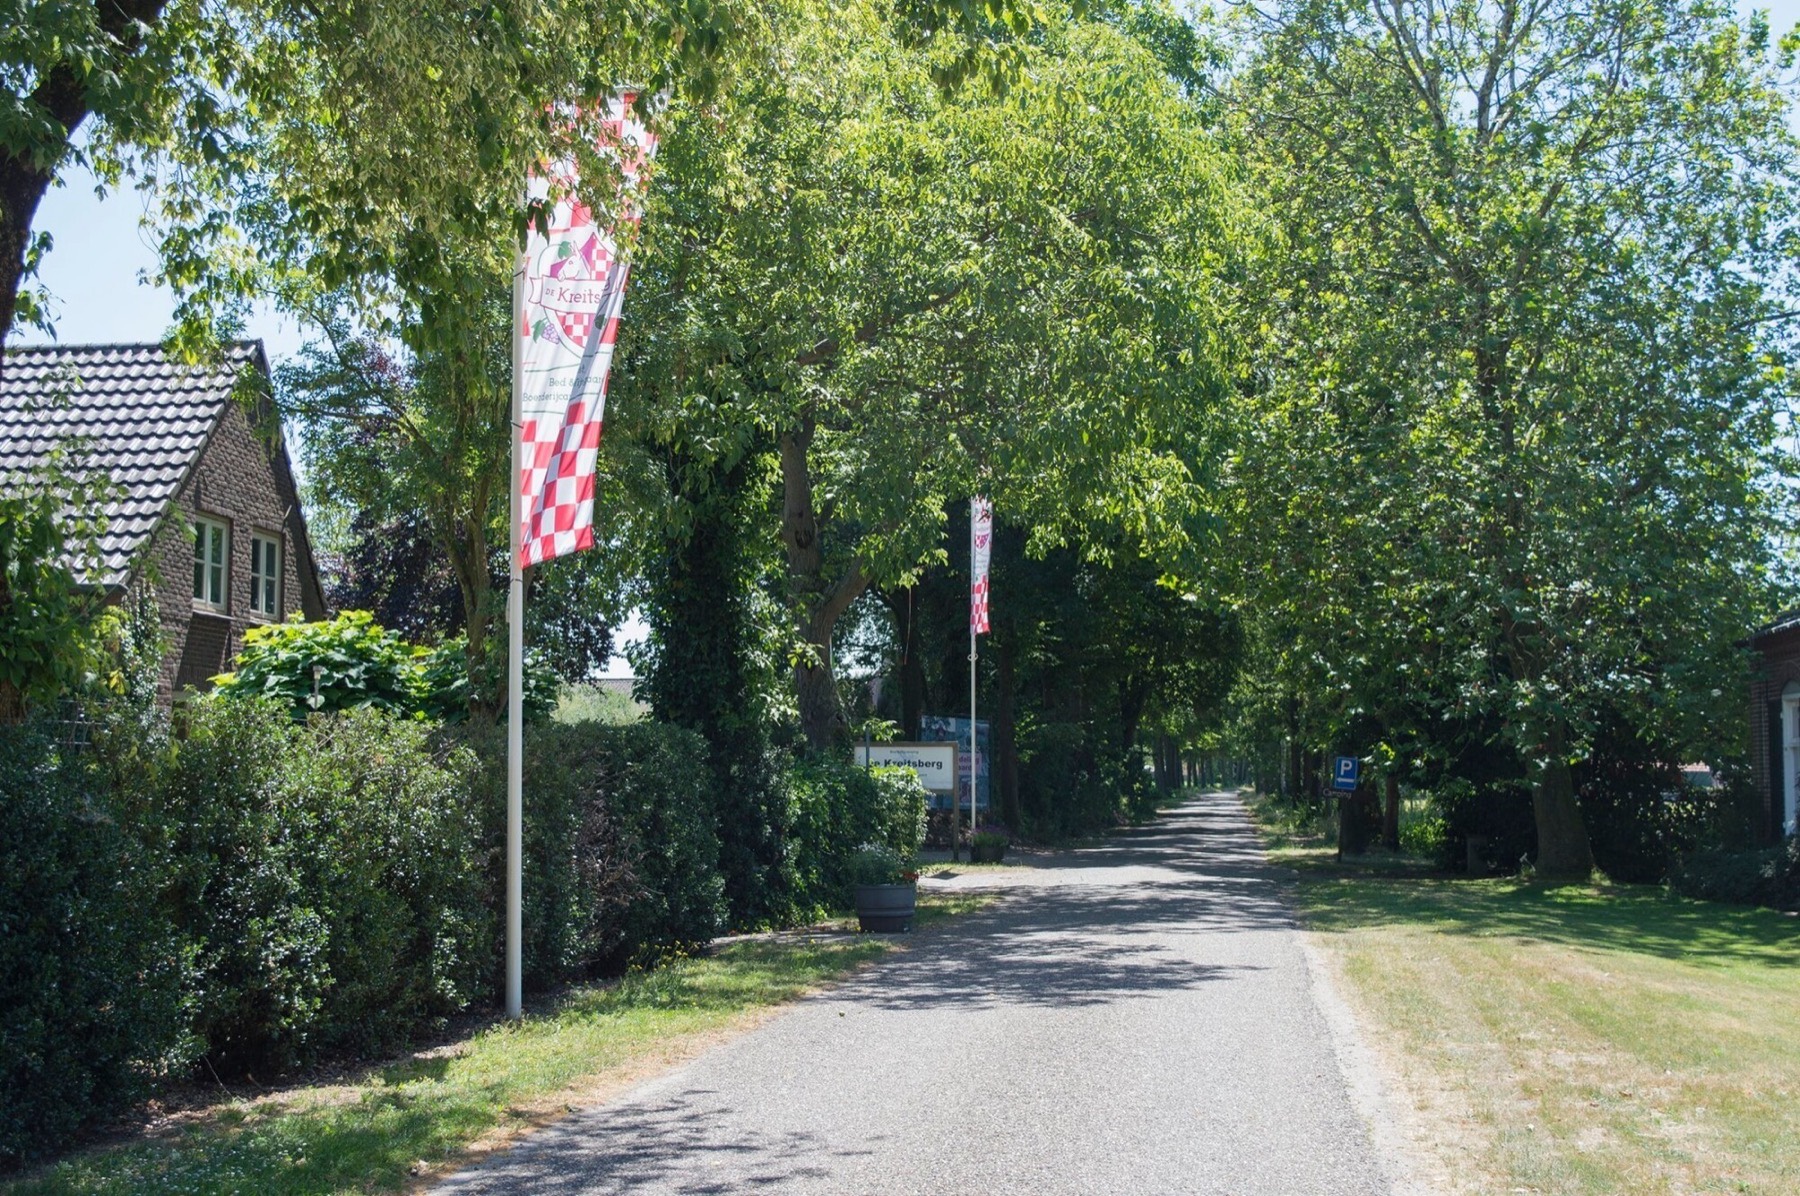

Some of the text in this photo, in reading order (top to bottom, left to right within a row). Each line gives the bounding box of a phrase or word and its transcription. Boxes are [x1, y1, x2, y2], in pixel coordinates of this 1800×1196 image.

[545, 287, 601, 304] DE Kreits
[549, 377, 566, 387] Bed
[523, 391, 569, 403] Boerderijca
[1340, 760, 1353, 776] P
